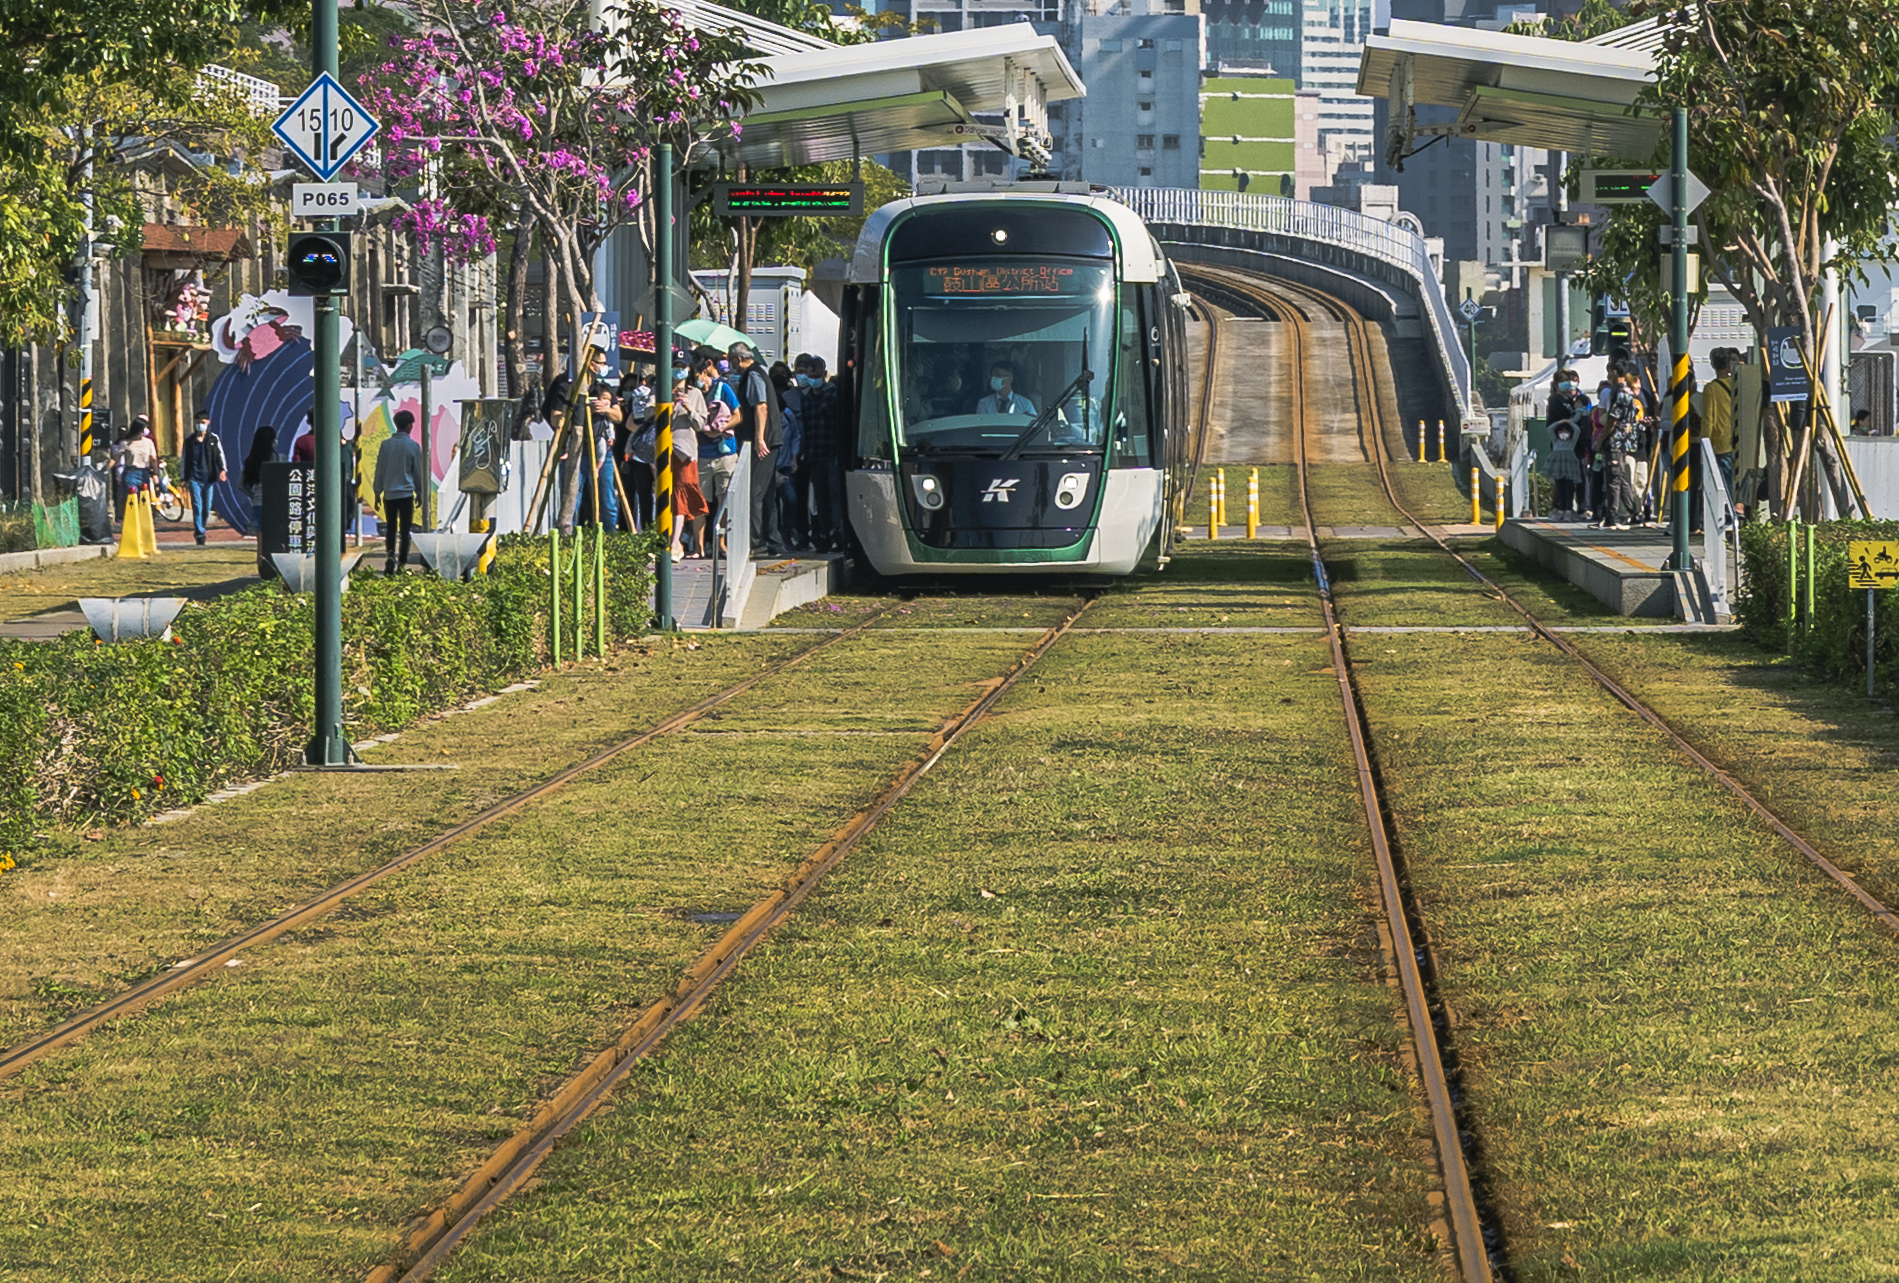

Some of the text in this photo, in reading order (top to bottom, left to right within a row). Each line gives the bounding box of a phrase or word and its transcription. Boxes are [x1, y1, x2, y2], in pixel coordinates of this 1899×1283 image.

[297, 107, 354, 132] 15 10
[303, 192, 349, 206] P065
[1464, 304, 1475, 315] 40
